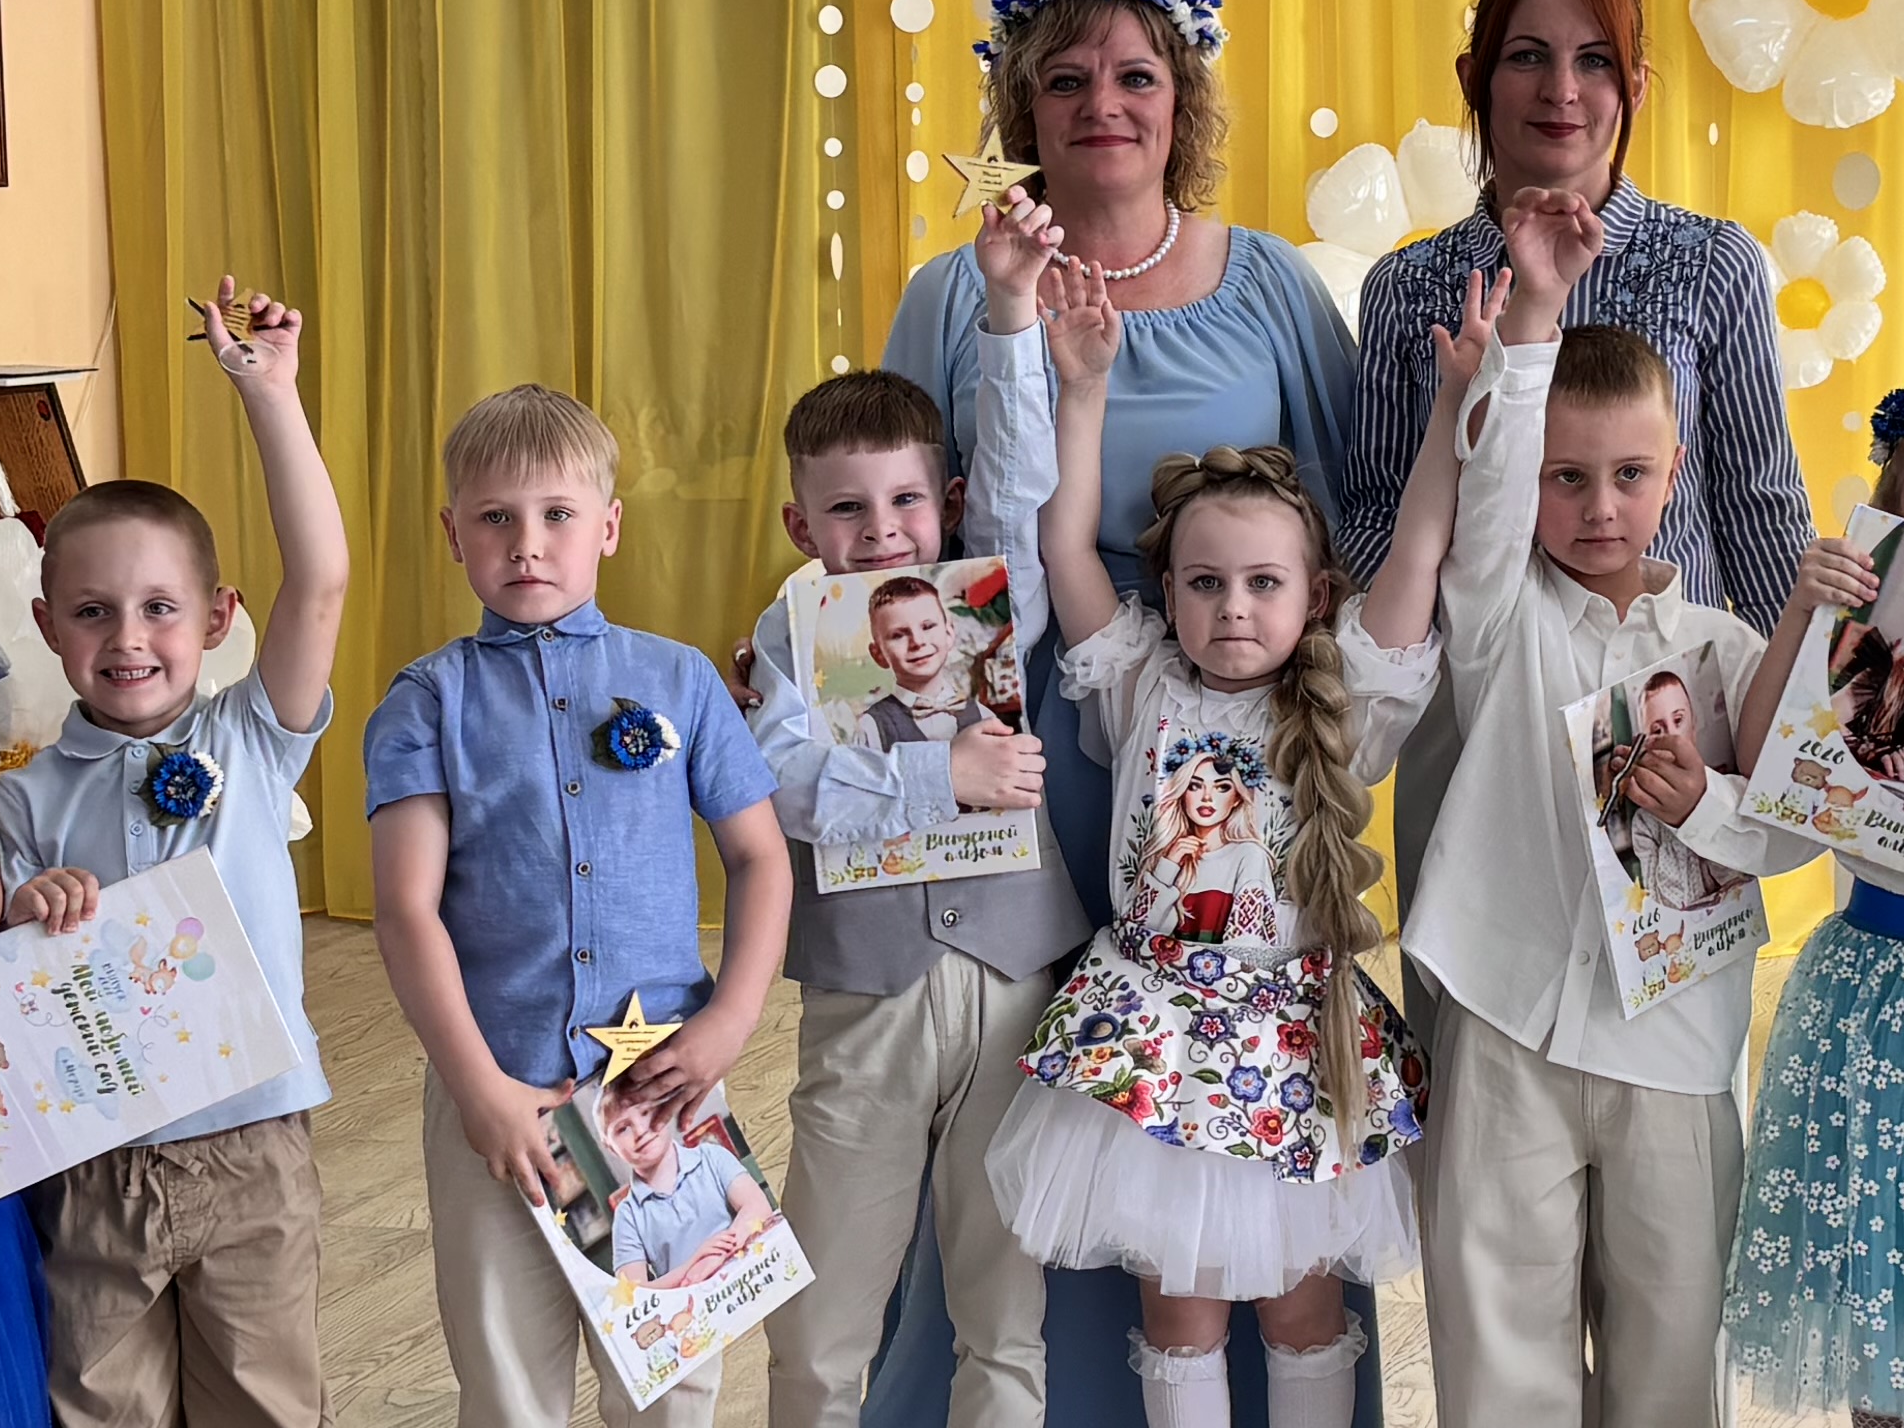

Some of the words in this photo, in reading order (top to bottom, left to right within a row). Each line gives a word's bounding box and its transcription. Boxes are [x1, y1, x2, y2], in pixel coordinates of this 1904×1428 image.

[1798, 739, 1846, 765] 2026
[925, 824, 1018, 851] Выпускной
[1632, 907, 1662, 935] 2026
[71, 964, 104, 1004] Мой
[94, 1063, 119, 1095] сад
[704, 1246, 782, 1315] Выпускной
[625, 1292, 662, 1330] 2026
